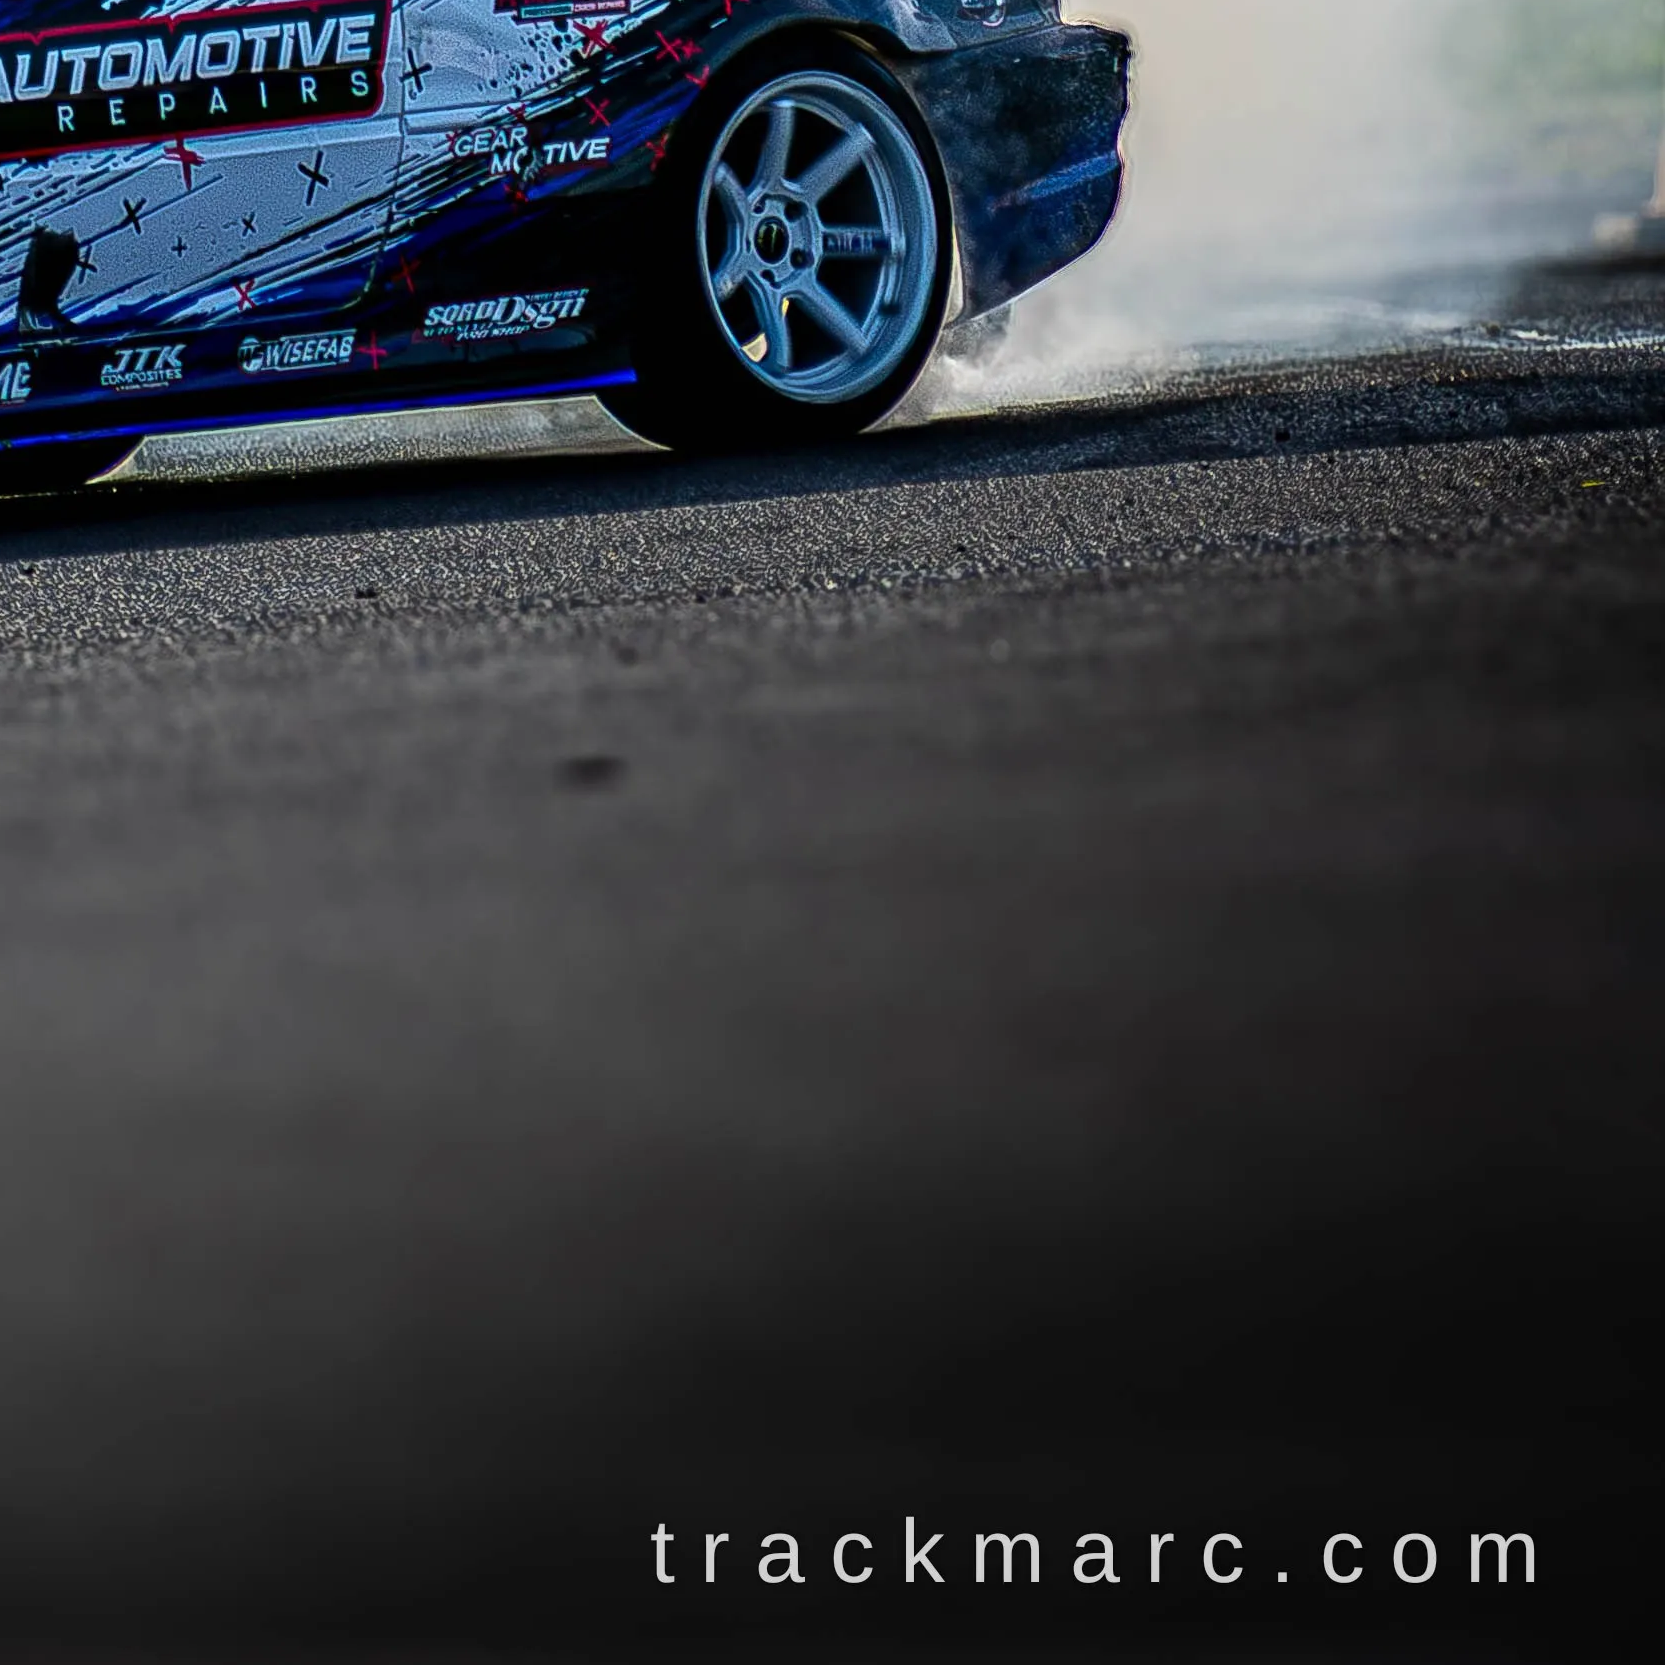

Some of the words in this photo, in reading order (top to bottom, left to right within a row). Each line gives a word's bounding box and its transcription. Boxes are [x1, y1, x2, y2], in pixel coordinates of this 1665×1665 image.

[57, 69, 370, 133] REPAIRS
[454, 125, 529, 158] GEAR
[102, 344, 187, 374] JTK
[265, 335, 355, 368] WISEFAB
[100, 368, 183, 386] COMPOSITES
